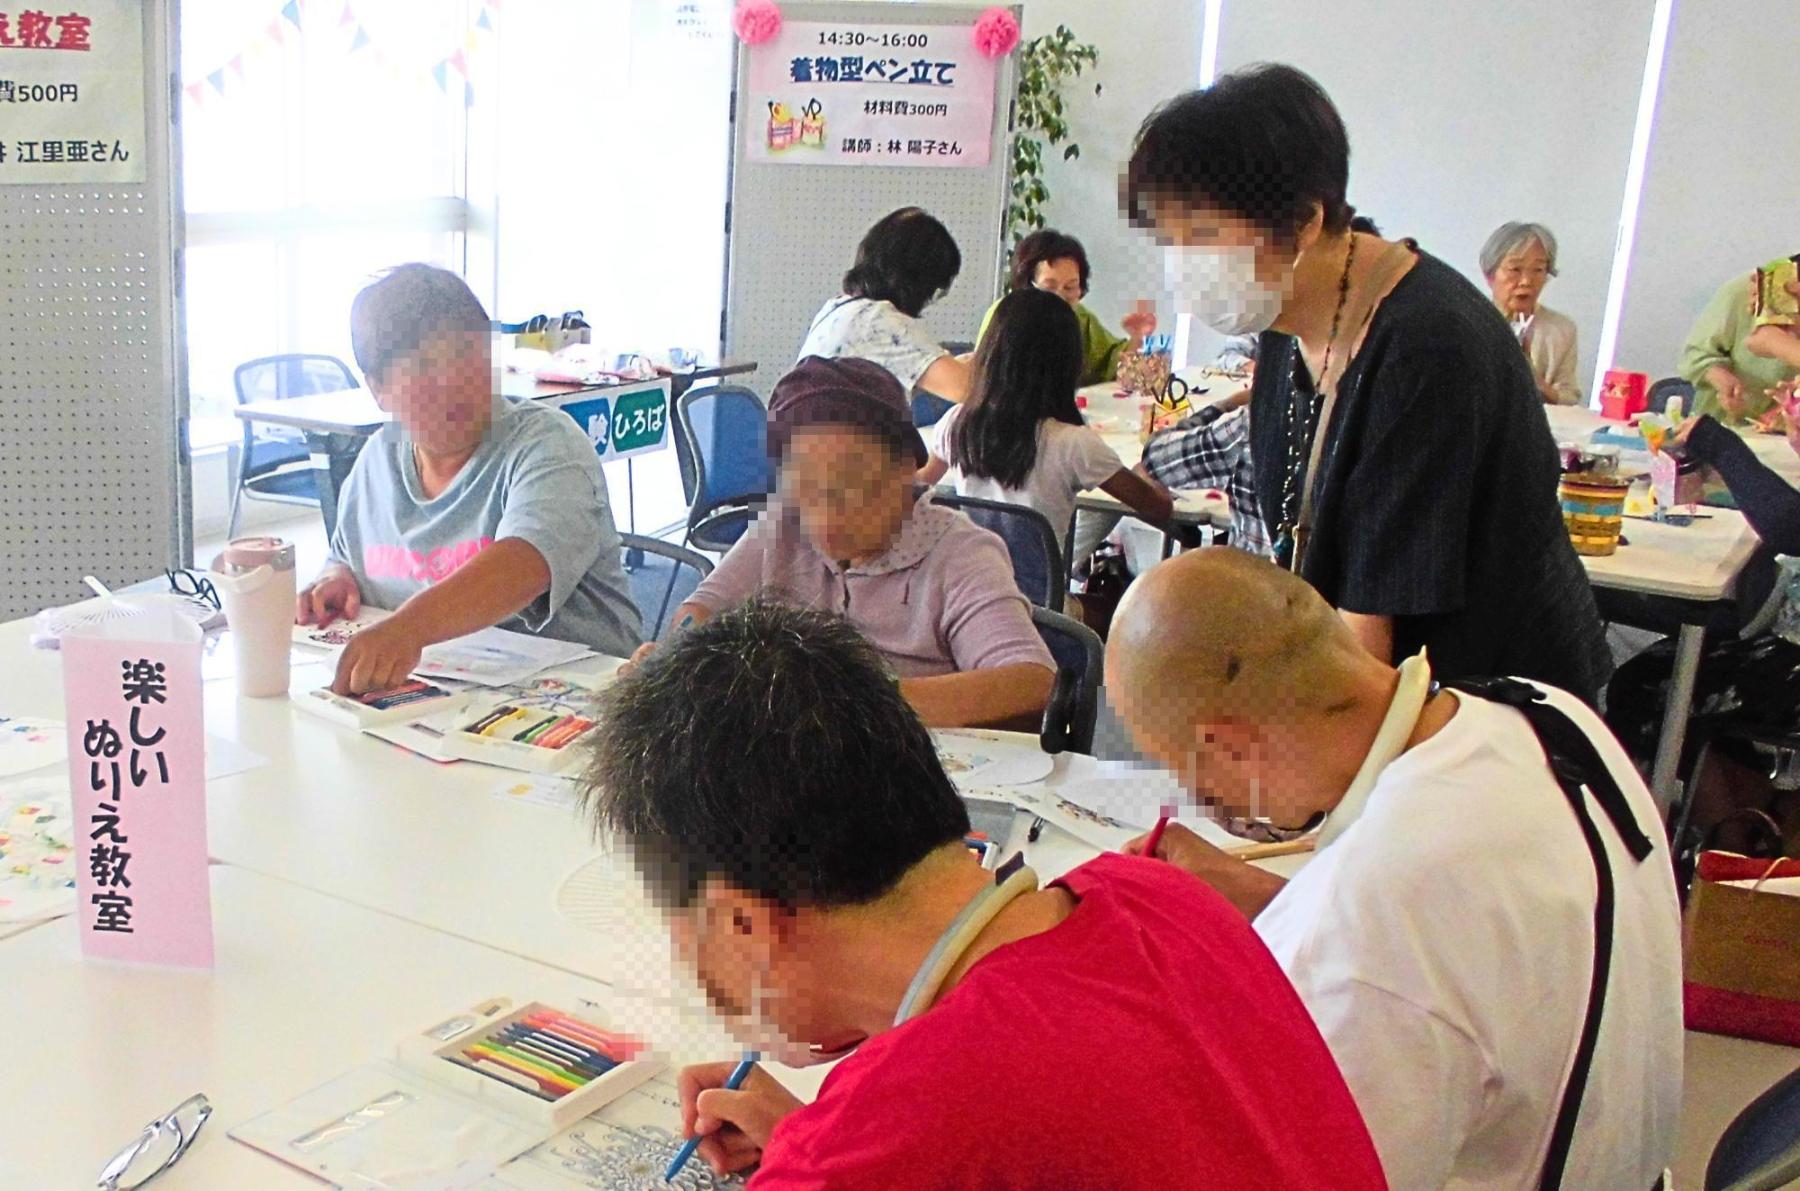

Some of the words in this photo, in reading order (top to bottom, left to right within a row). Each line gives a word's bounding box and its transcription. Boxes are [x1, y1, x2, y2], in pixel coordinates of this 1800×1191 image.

[790, 56, 957, 84] 着物型ペン立て
[863, 99, 948, 117] 材料費300円
[16, 139, 130, 163] 江里亜さん
[614, 403, 665, 440] ひろば
[121, 658, 170, 788] 楽しい
[83, 718, 135, 934] ぬりえ教室
